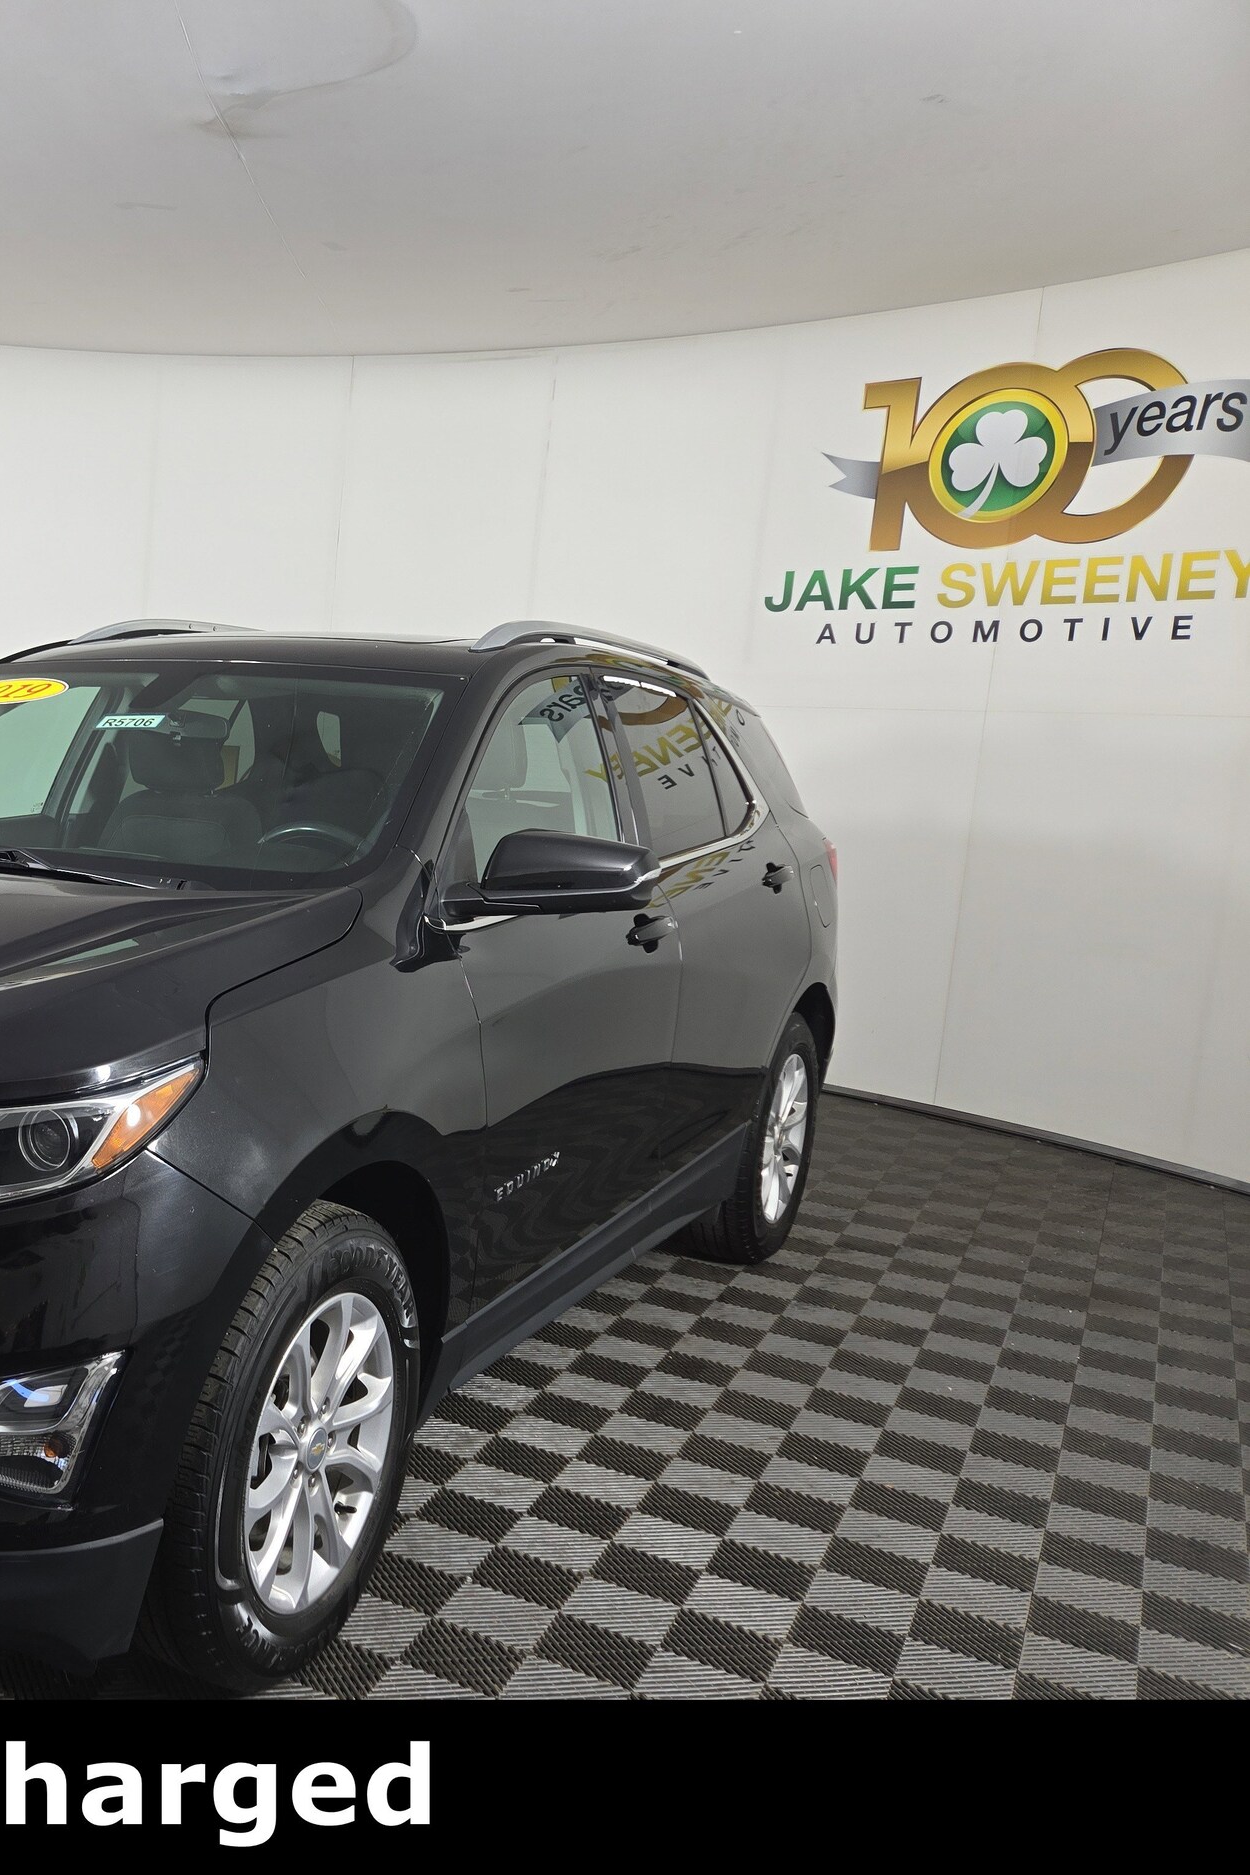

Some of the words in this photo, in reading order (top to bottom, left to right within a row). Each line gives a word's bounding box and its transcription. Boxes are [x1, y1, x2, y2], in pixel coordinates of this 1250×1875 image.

[863, 347, 1195, 553] 100
[1104, 389, 1248, 456] years
[764, 565, 920, 613] JAKE
[936, 549, 1250, 609] SWEENEY
[816, 615, 1194, 645] AUTOMOTIVE
[101, 718, 156, 728] R5706
